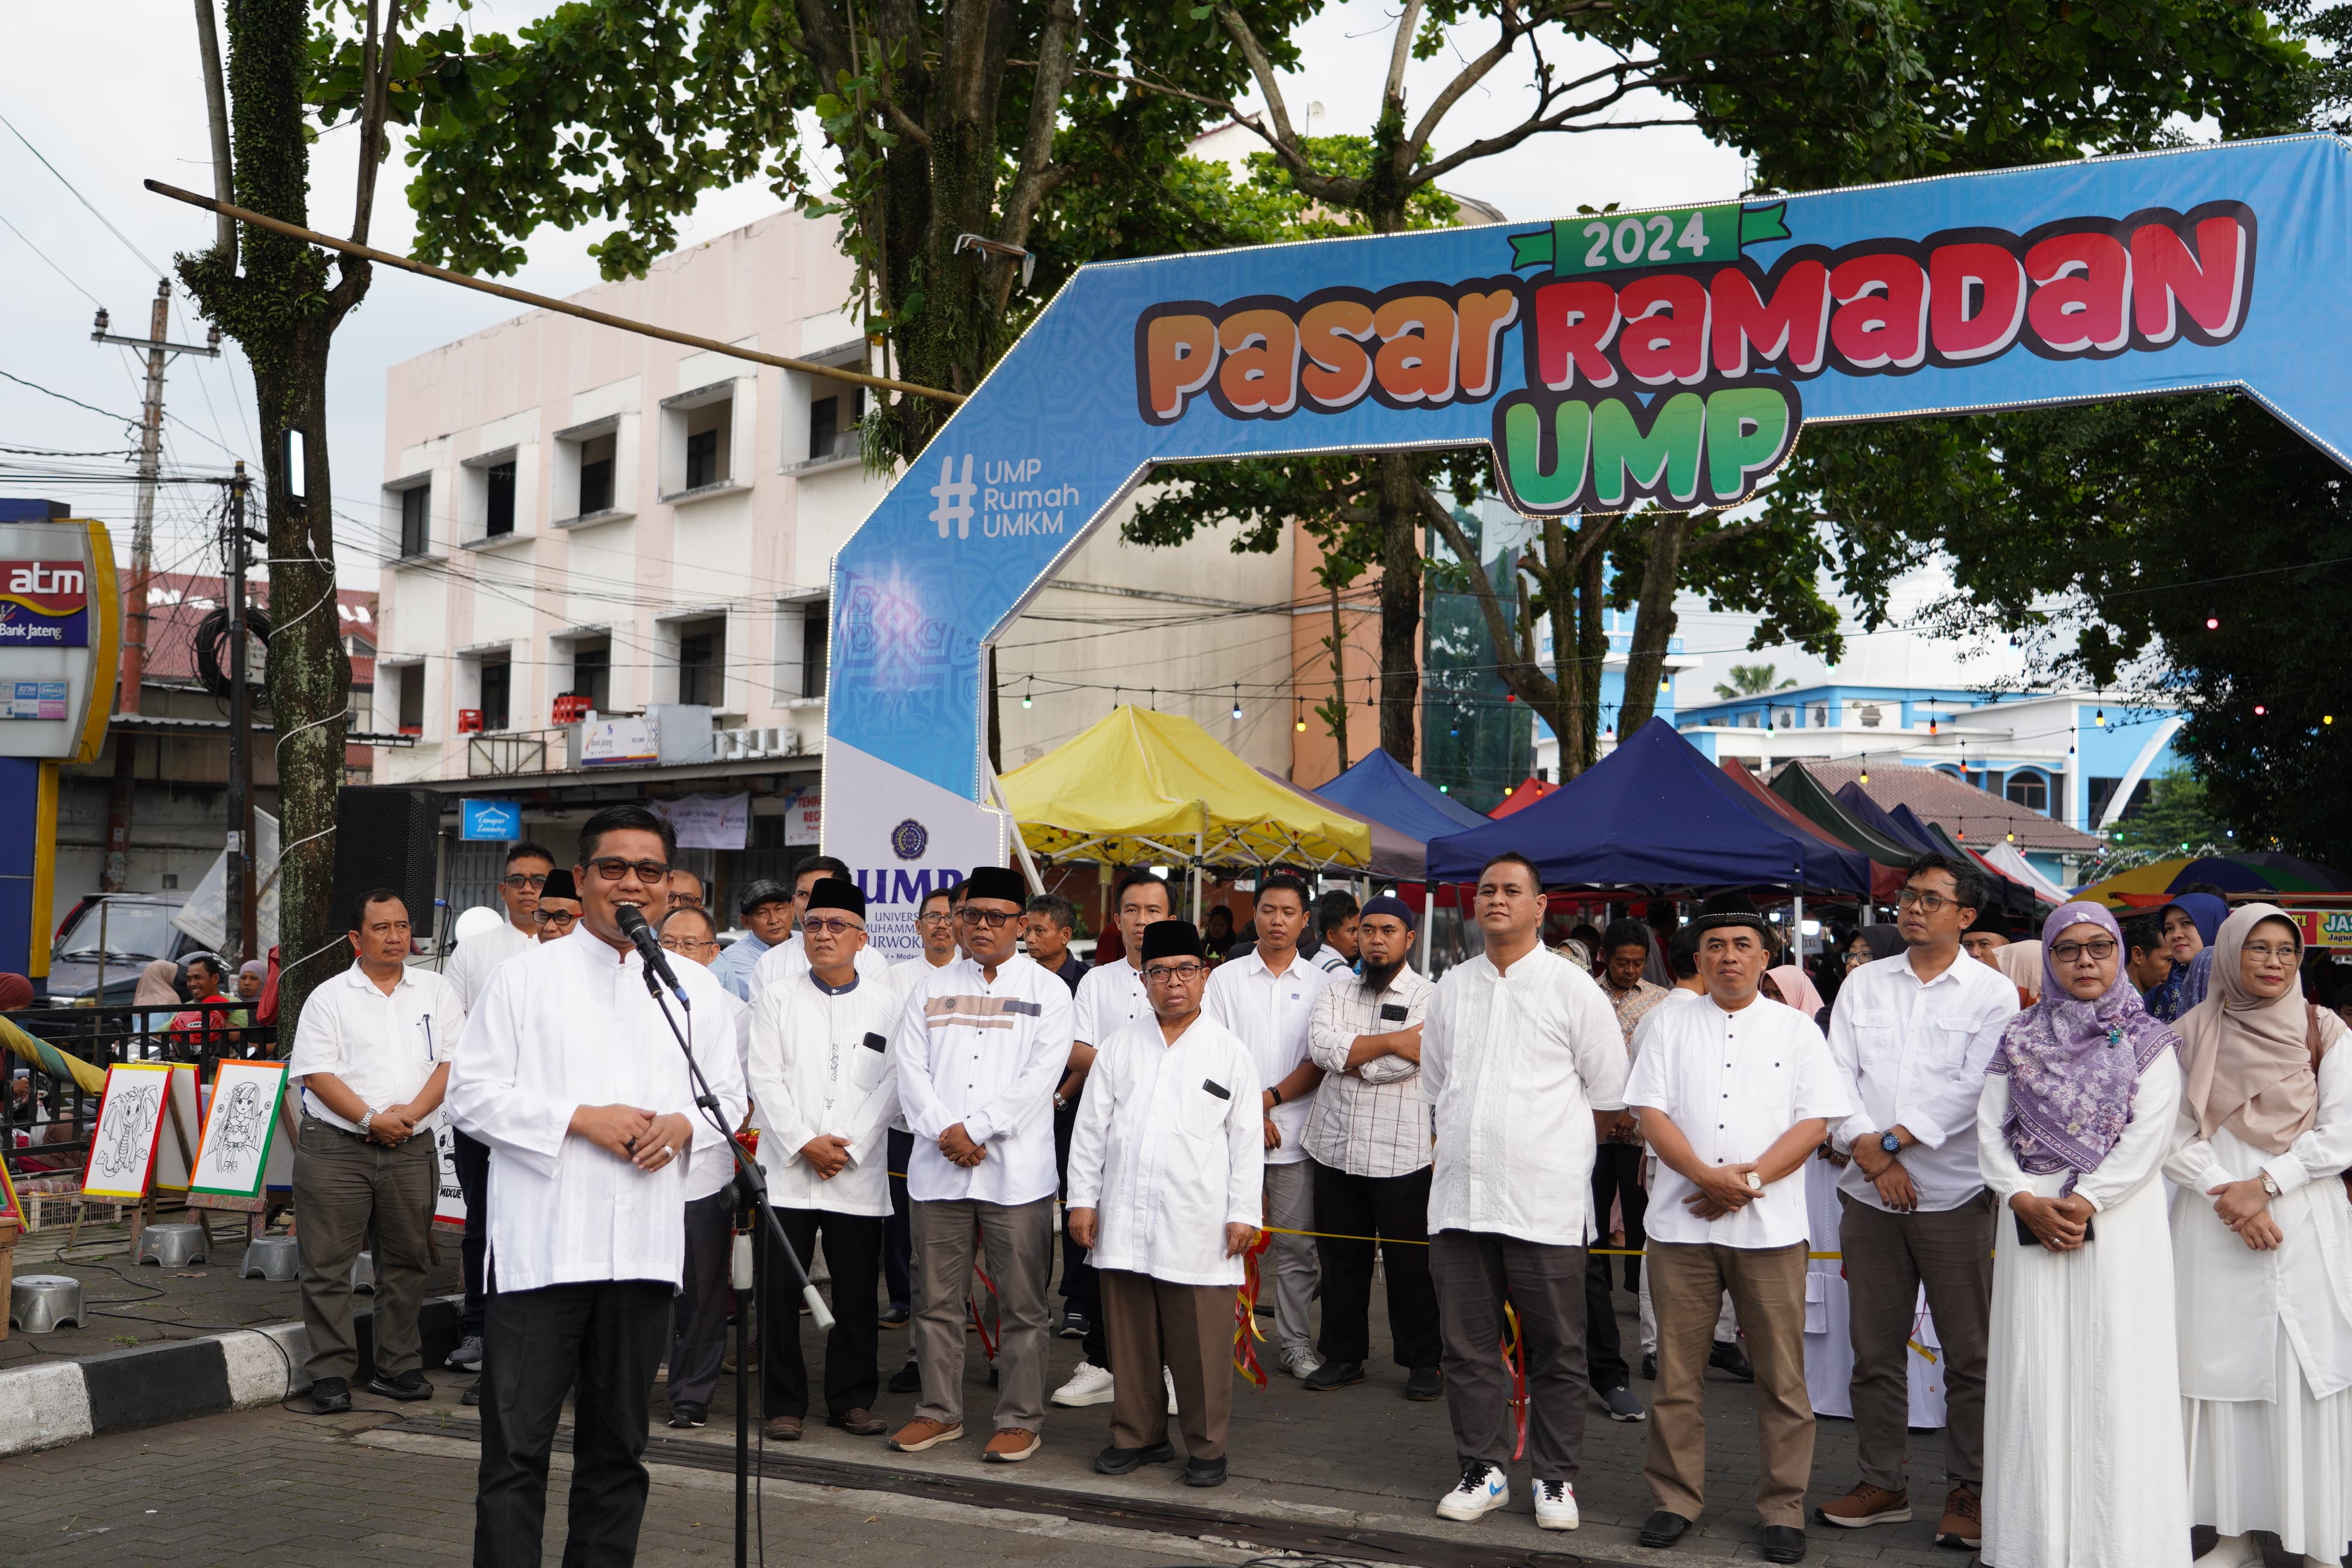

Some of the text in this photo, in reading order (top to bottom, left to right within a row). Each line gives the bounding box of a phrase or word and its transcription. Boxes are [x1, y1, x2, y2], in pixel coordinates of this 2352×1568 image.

[1582, 211, 1710, 268] 2024
[1505, 387, 1790, 508] UMP
[985, 458, 1042, 485] UMP
[984, 483, 1079, 511] Rumah
[984, 510, 1064, 538] UMKM
[10, 562, 84, 594] atm
[0, 623, 62, 641] Bank Jateng
[798, 795, 822, 808] TEMP
[803, 811, 822, 822] REG
[875, 912, 919, 921] UNIVERS
[2290, 914, 2307, 927] TI
[2325, 915, 2352, 932] JA
[865, 924, 917, 933] MUHAMM
[868, 936, 925, 948] URWOK
[439, 1187, 463, 1199] MIXUE
